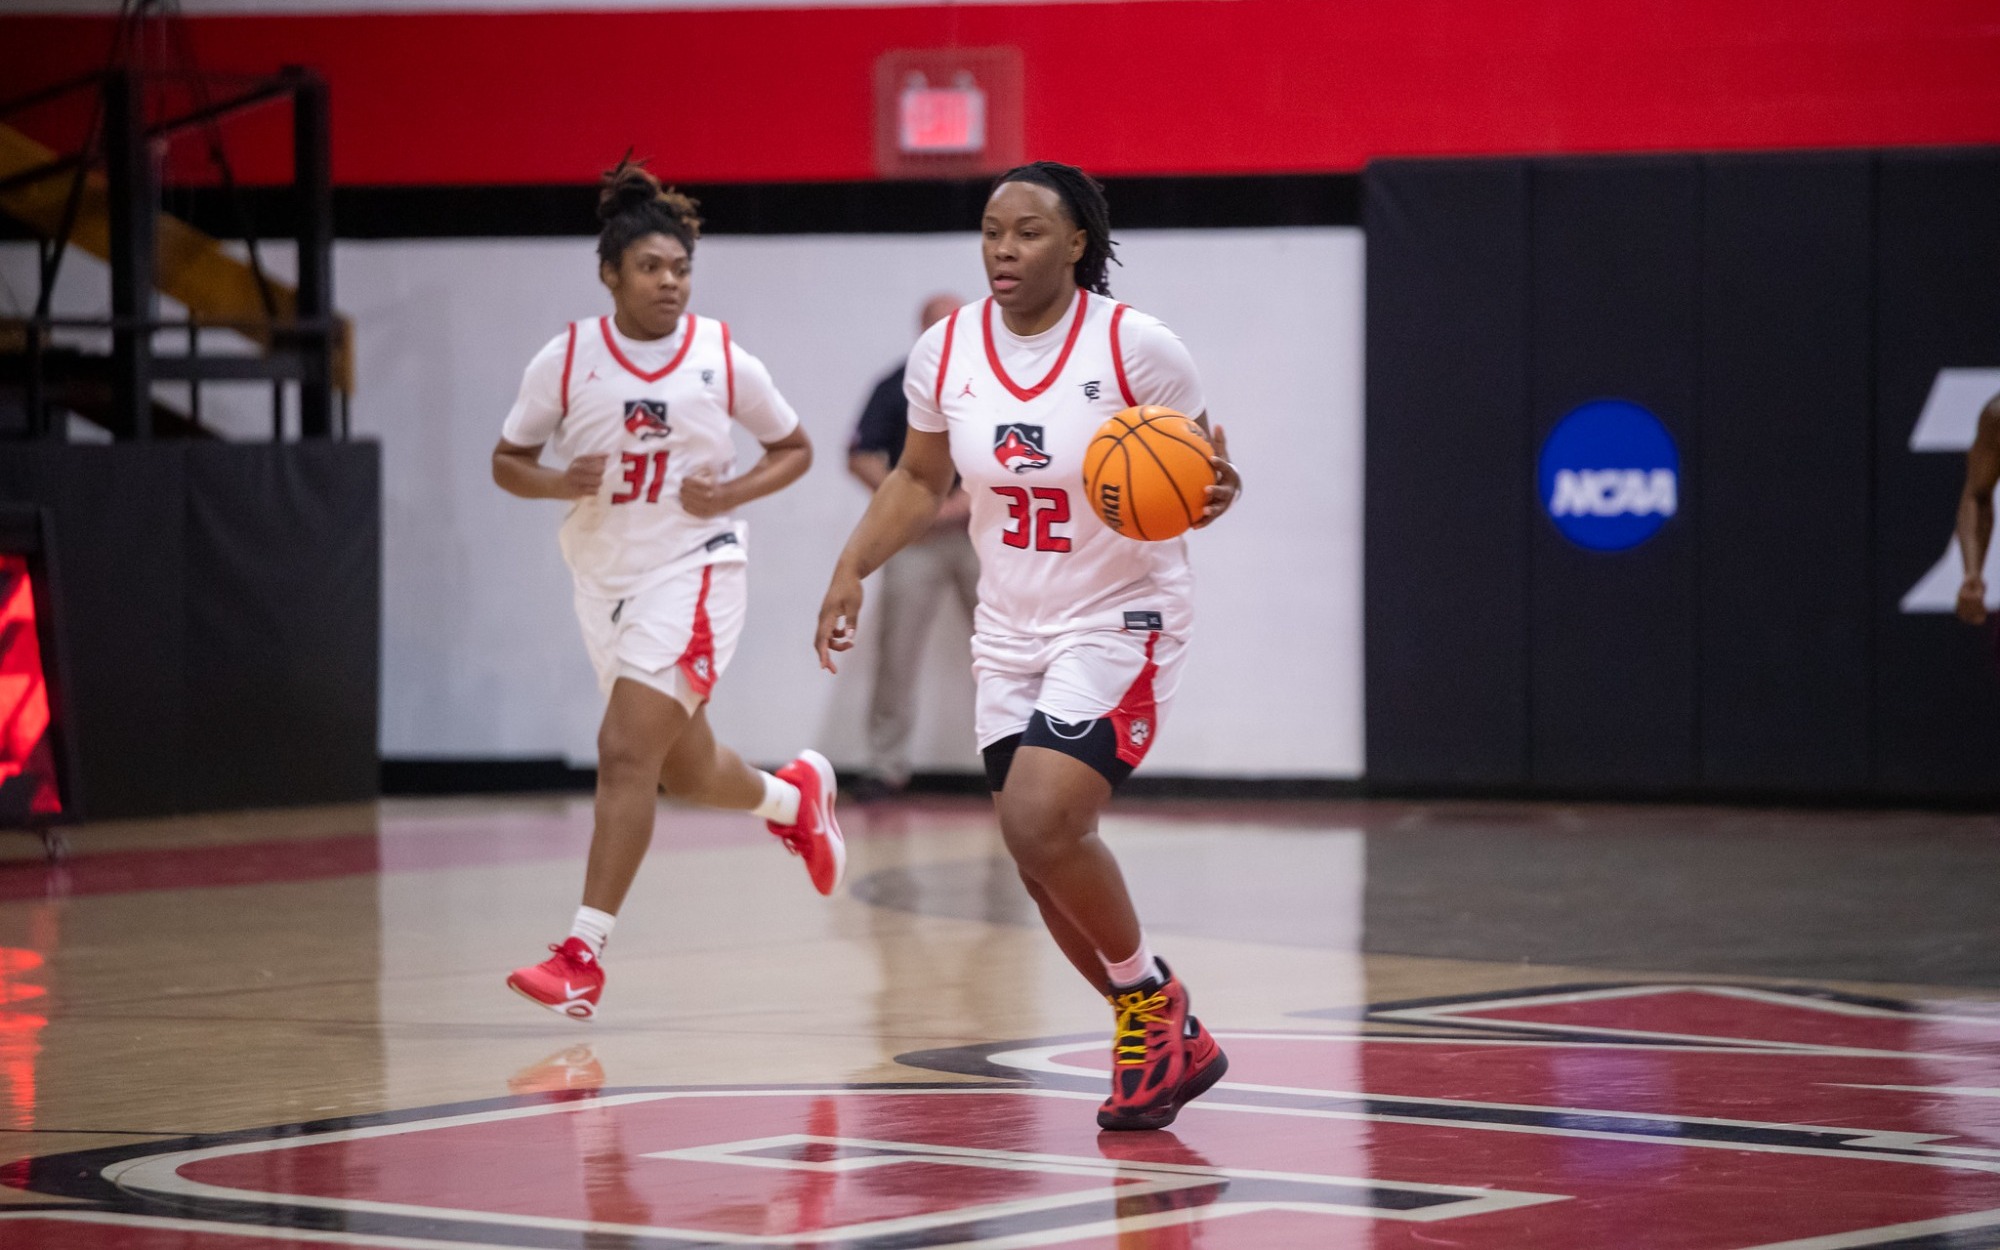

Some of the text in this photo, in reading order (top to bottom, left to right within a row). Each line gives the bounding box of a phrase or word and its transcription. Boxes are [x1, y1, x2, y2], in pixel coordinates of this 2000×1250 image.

[612, 450, 670, 505] 31
[1551, 467, 1677, 518] NCAA
[990, 486, 1072, 553] 32
